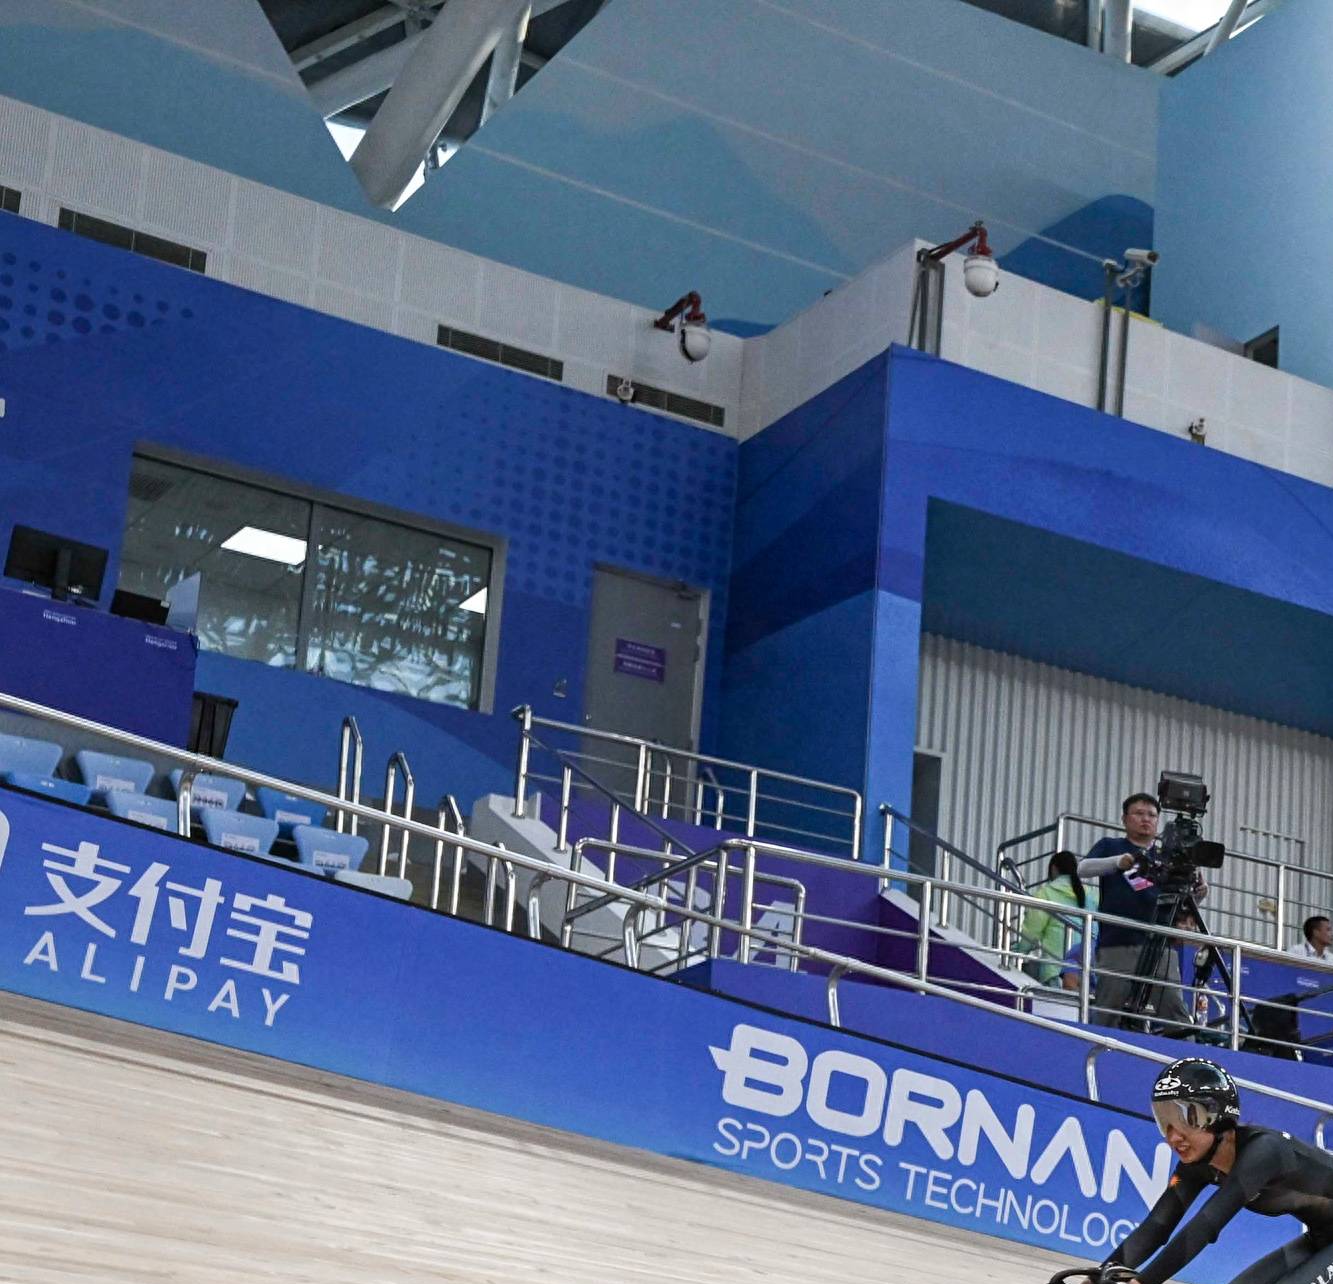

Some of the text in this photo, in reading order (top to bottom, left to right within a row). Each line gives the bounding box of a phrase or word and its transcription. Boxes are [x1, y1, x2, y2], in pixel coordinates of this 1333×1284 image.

[23, 931, 290, 1027] ALIPAY
[24, 841, 313, 985] 支付宝
[707, 1023, 1172, 1212] BORNAN
[712, 1117, 1143, 1249] SPORTS TECHNOLOG
